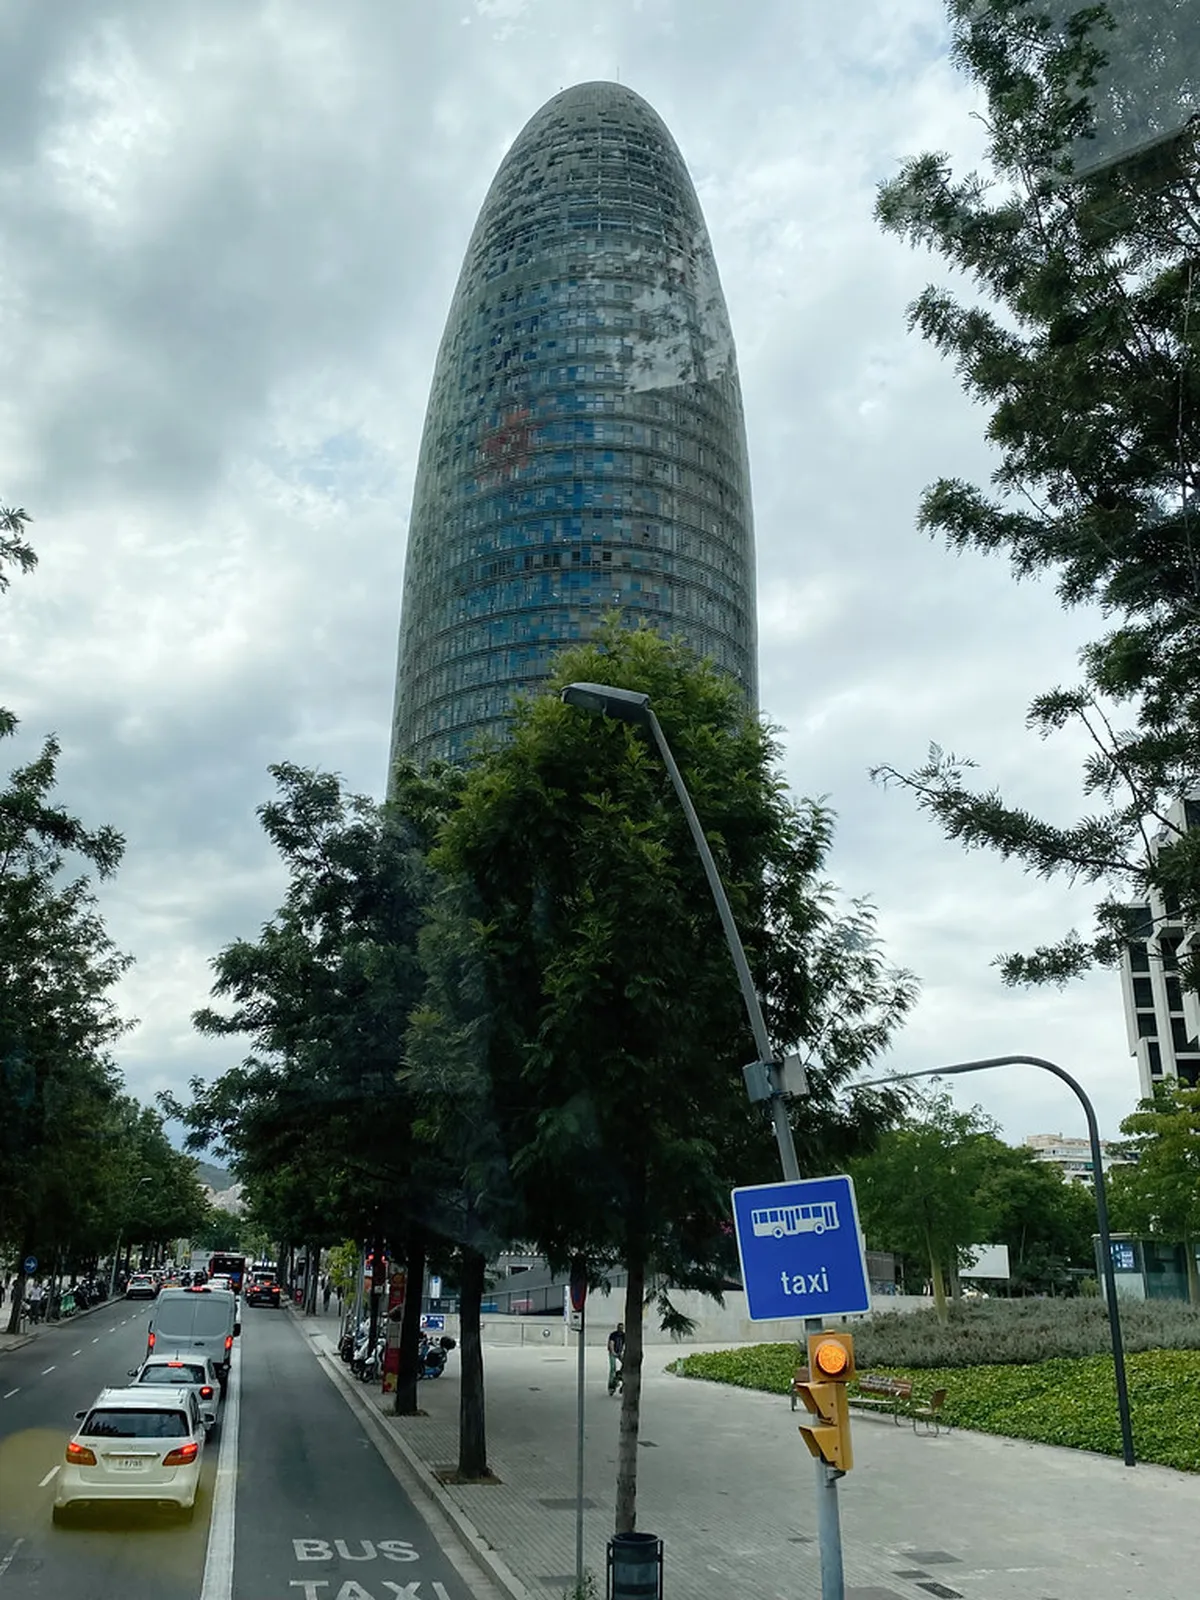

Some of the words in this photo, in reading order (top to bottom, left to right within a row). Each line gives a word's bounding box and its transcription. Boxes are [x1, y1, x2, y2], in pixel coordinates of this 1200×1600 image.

[780, 1266, 829, 1295] taxi
[292, 1539, 420, 1562] BUS
[289, 1580, 451, 1600] TAXI
